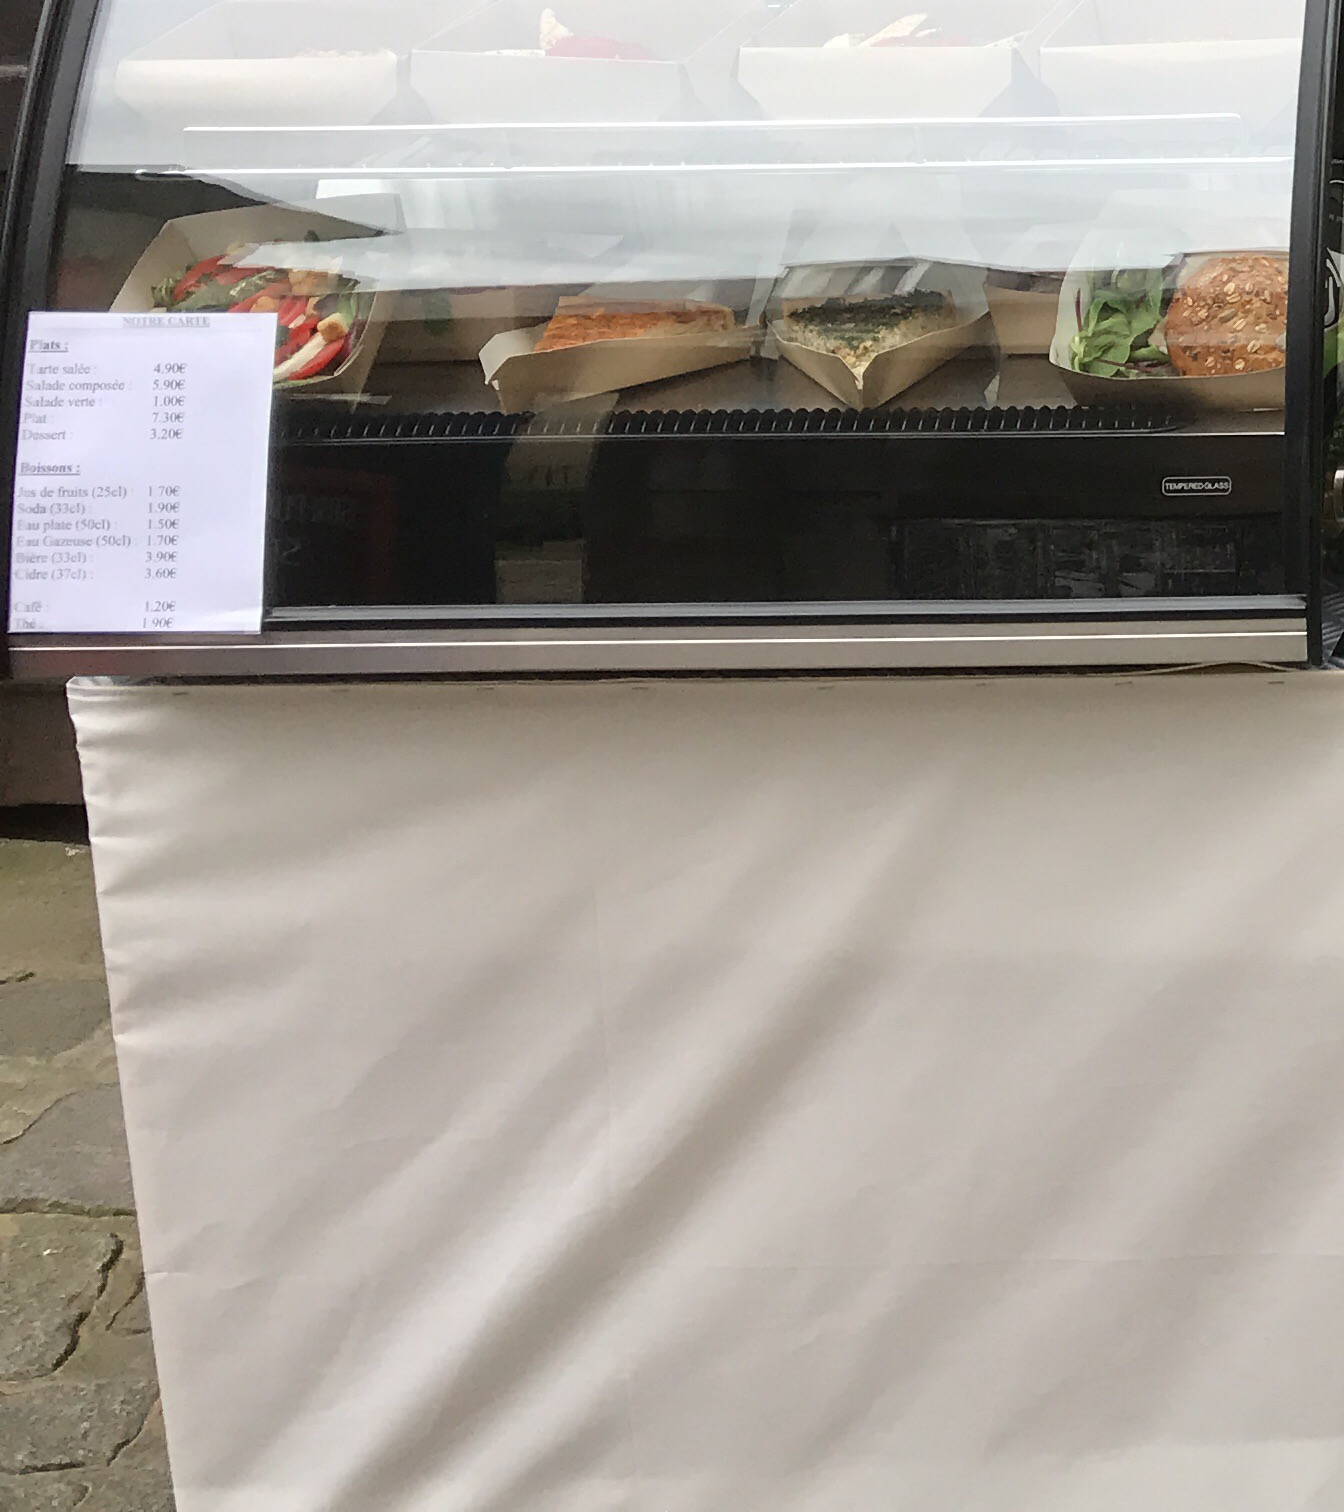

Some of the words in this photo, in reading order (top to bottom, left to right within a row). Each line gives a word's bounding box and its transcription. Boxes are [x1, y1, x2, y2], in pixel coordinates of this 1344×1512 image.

[168, 316, 210, 327] CARTE
[153, 362, 186, 374] 4.90€
[27, 380, 65, 391] Salade
[152, 379, 186, 391] 5.90€
[25, 396, 64, 407] Salade
[68, 397, 96, 407] verte
[153, 396, 185, 407] 1.00€
[152, 412, 184, 423] 7.30€
[150, 428, 183, 440] 3.20€
[40, 486, 54, 498] de
[57, 486, 88, 498] fruits
[92, 486, 128, 499] (25cl)
[17, 503, 46, 514] Soda
[50, 503, 86, 515] (33cl)
[148, 502, 180, 513] 1.90€
[42, 519, 72, 533] plate
[75, 519, 111, 532] (50cl)
[147, 519, 179, 530] 1.50€
[96, 535, 132, 548] (50cl)
[51, 552, 87, 564] (33cl)
[145, 552, 178, 563] 3.90€
[51, 568, 87, 580] (37cl)
[144, 568, 177, 579] 3.60€
[144, 601, 176, 612] 1.20€
